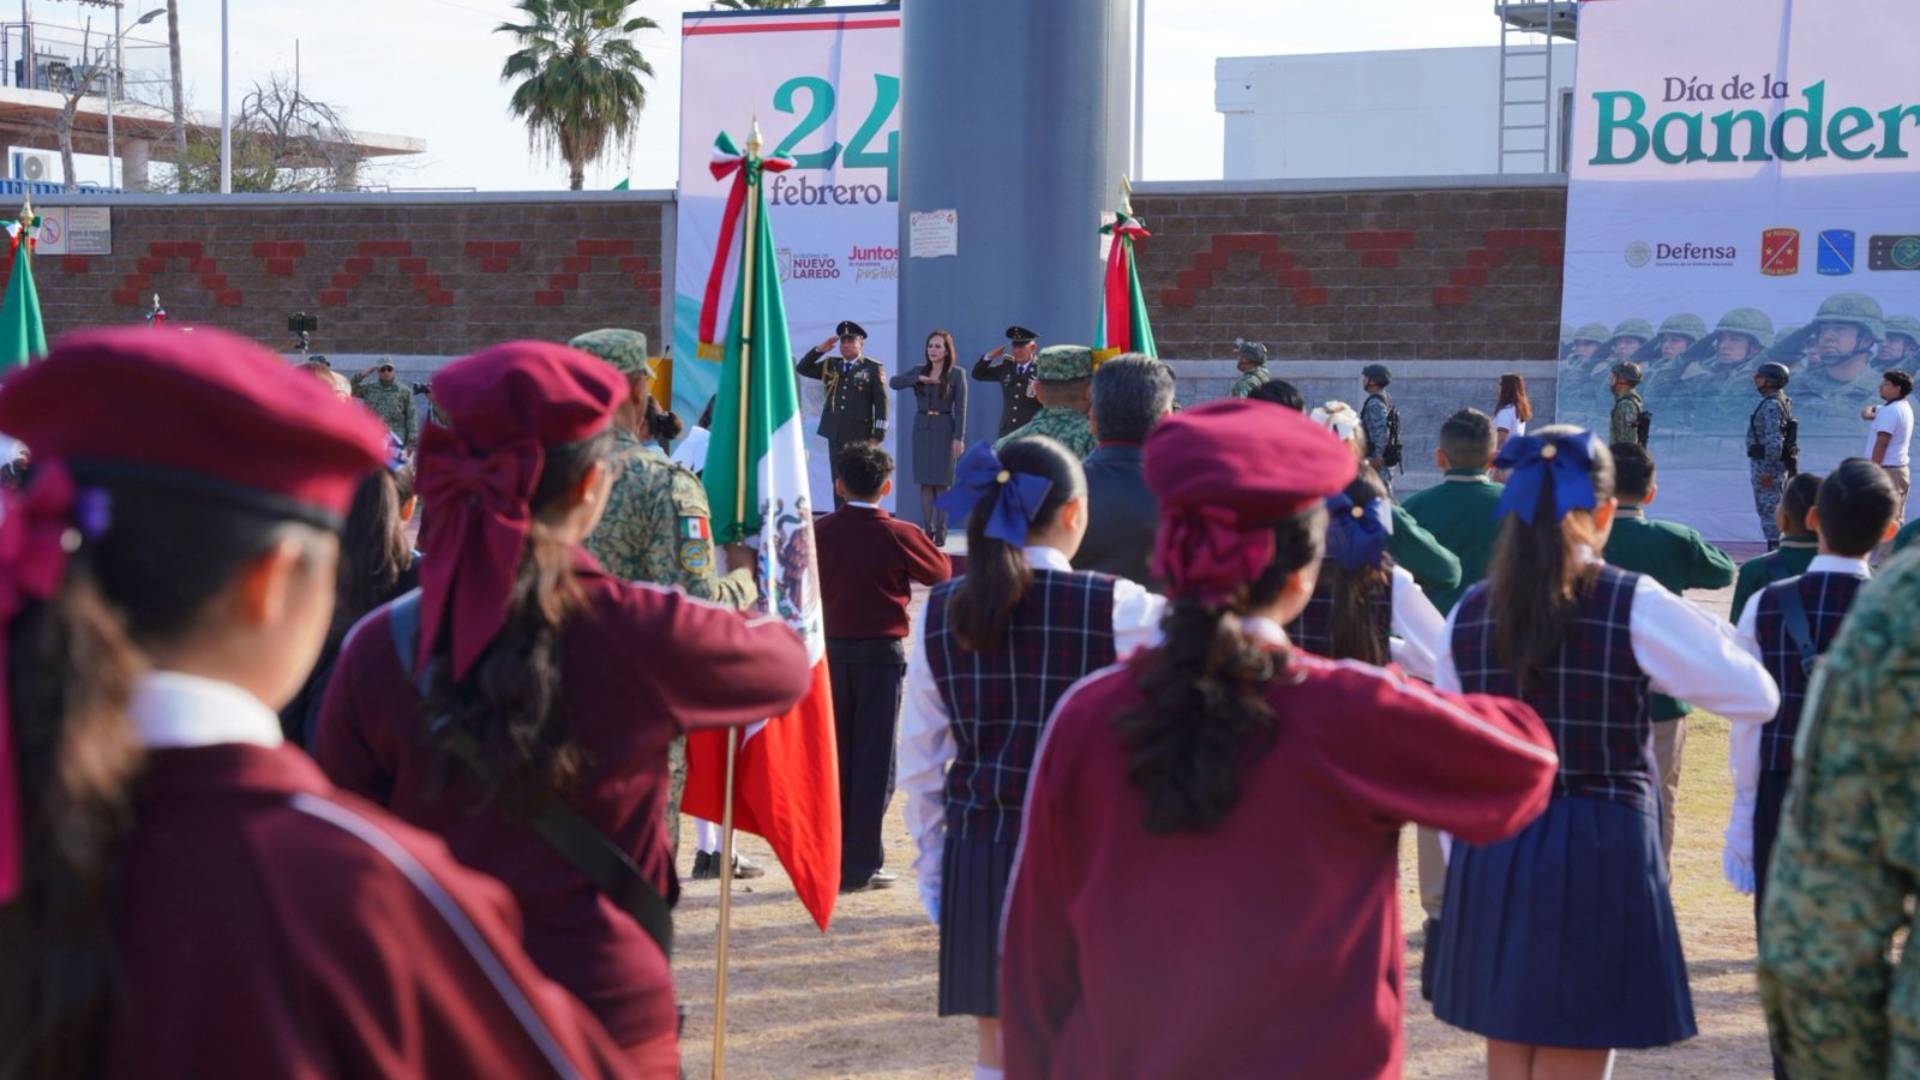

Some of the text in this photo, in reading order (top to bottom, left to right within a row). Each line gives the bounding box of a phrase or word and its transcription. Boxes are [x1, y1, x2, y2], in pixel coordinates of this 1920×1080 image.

[1662, 73, 1790, 102] Día de la
[768, 73, 900, 202] 24
[771, 175, 882, 206] febrero
[1656, 242, 1736, 260] Defensa
[793, 258, 836, 269] NUEVO
[793, 268, 841, 279] LAREDO
